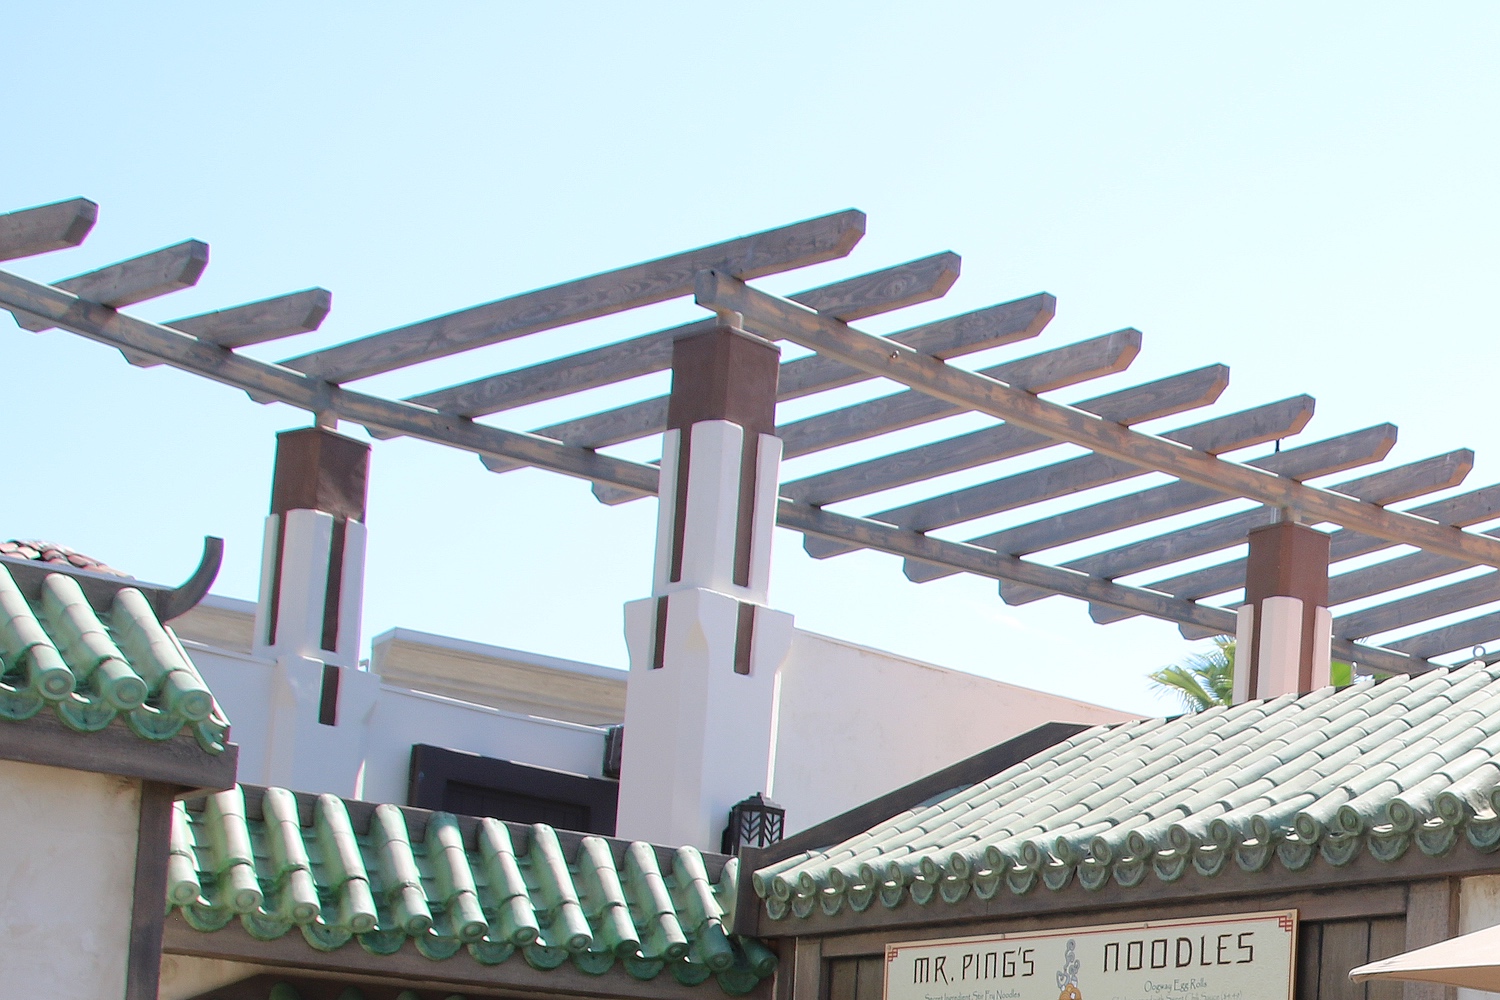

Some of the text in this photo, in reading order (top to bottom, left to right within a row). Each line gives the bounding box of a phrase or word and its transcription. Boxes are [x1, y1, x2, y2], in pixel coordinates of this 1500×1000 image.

[912, 931, 1255, 986] MR. PING'S NOODLES
[996, 988, 1021, 1000] Noodles
[1143, 977, 1208, 994] Oogway Egg Rolls
